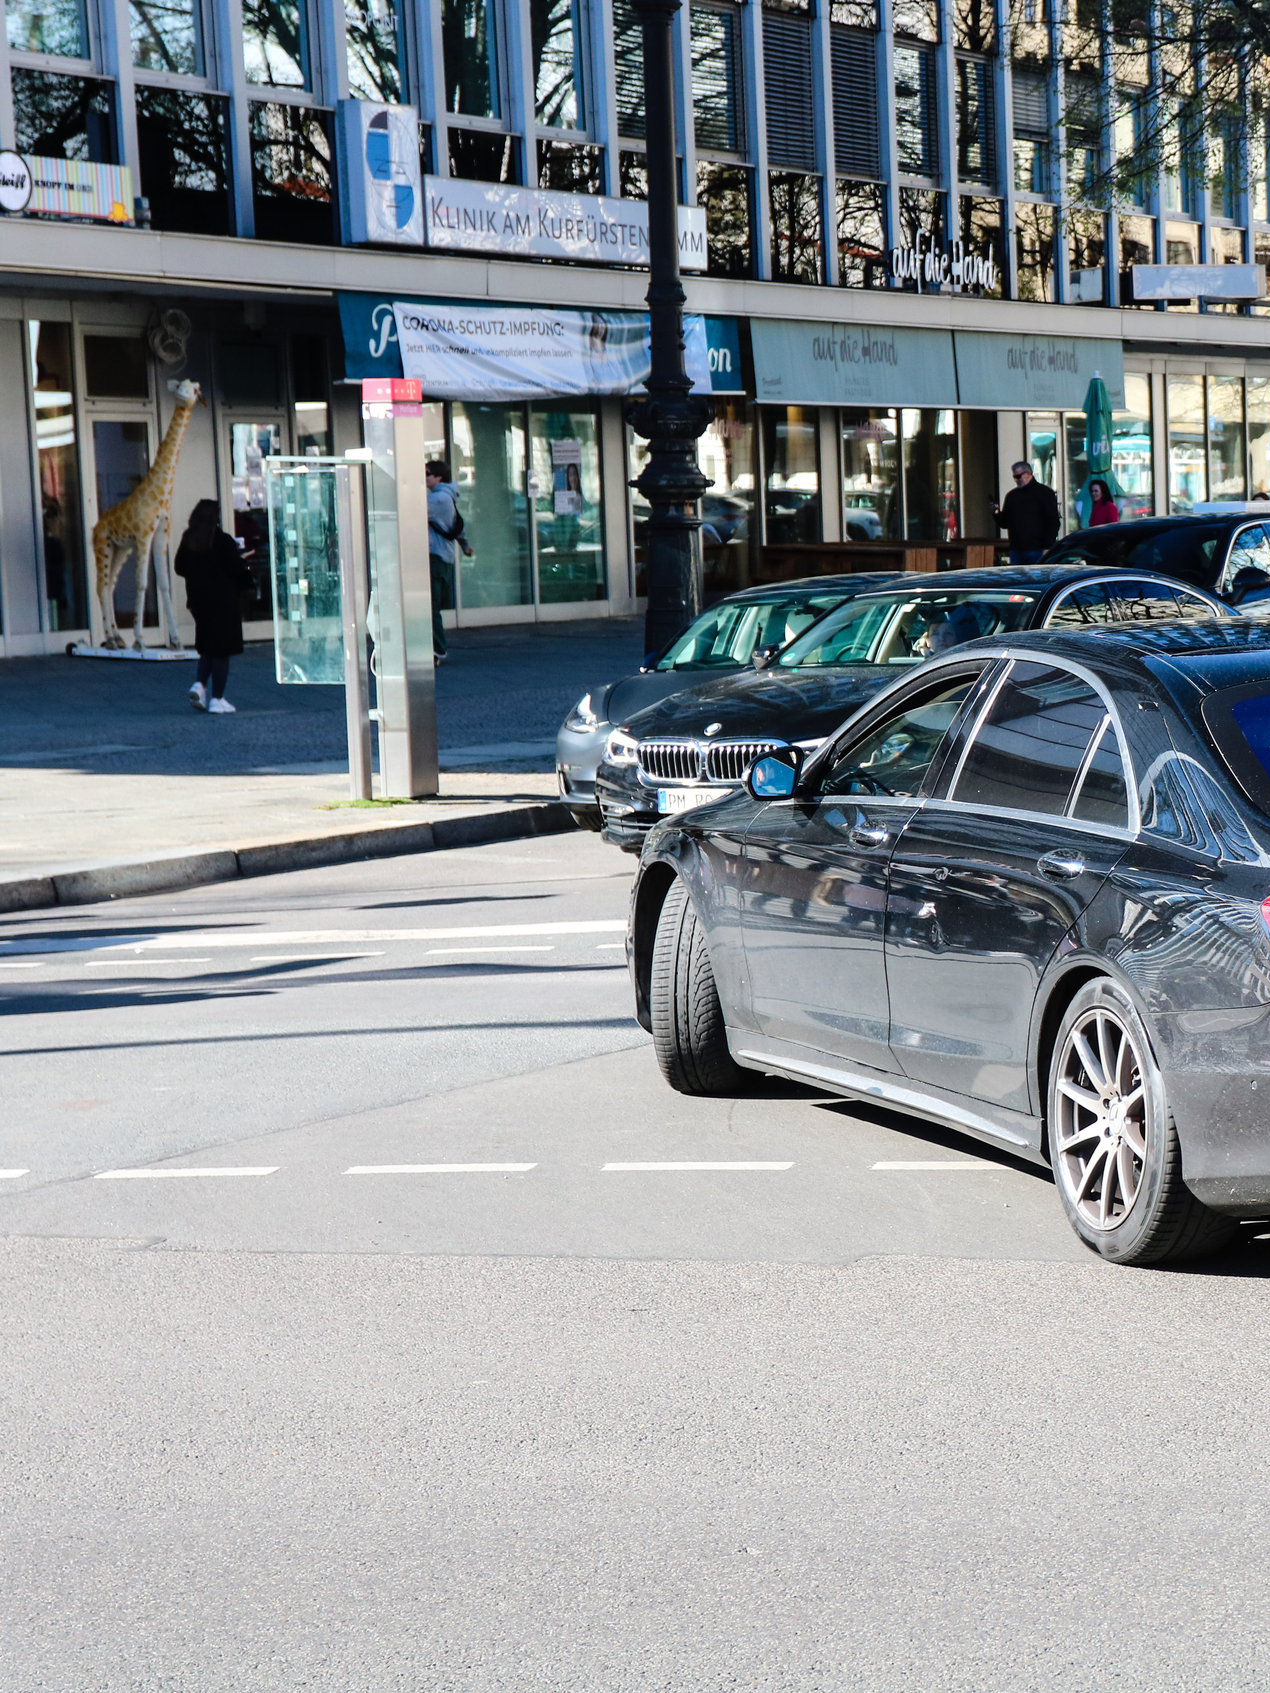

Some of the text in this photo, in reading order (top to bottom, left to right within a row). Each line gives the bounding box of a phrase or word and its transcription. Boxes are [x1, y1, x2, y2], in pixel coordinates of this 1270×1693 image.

[431, 196, 704, 254] KLINIK AM KURFÜRSTENMM
[892, 228, 999, 294] auf die Hand
[402, 315, 565, 337] CORONA-SCHUTZ-IMPFUNG:
[812, 323, 898, 372] auf die Hand
[406, 343, 424, 353] Jetzt
[425, 344, 441, 354] HIER
[442, 345, 470, 354] schnell
[529, 348, 552, 358] impfen
[1007, 336, 1079, 380] auf die Hand
[668, 793, 686, 809] PM
